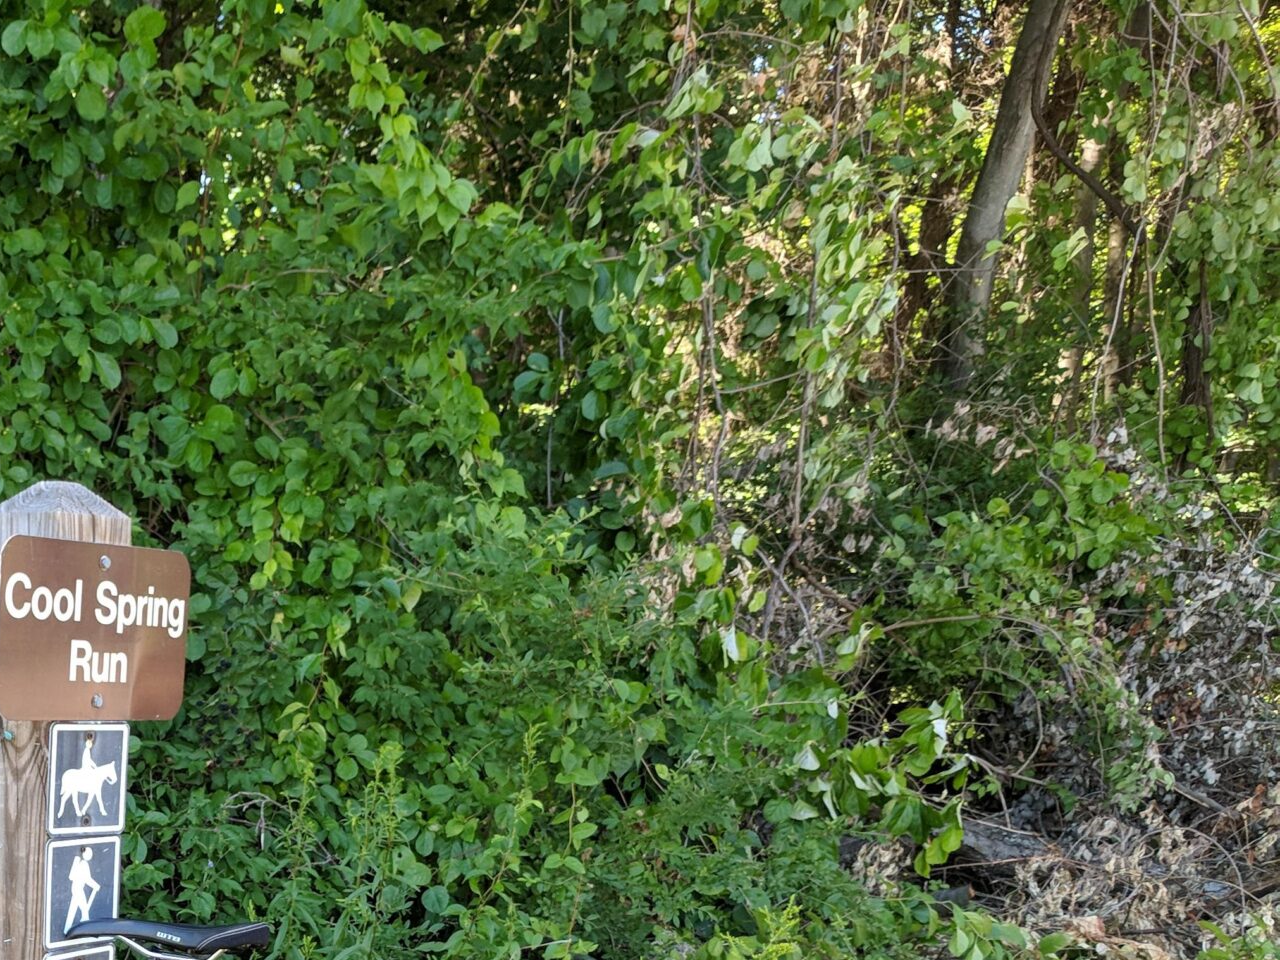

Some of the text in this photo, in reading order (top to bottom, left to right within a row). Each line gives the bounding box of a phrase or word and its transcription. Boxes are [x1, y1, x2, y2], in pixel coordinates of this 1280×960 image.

[5, 572, 186, 638] Cool Spring
[69, 639, 128, 683] Run
